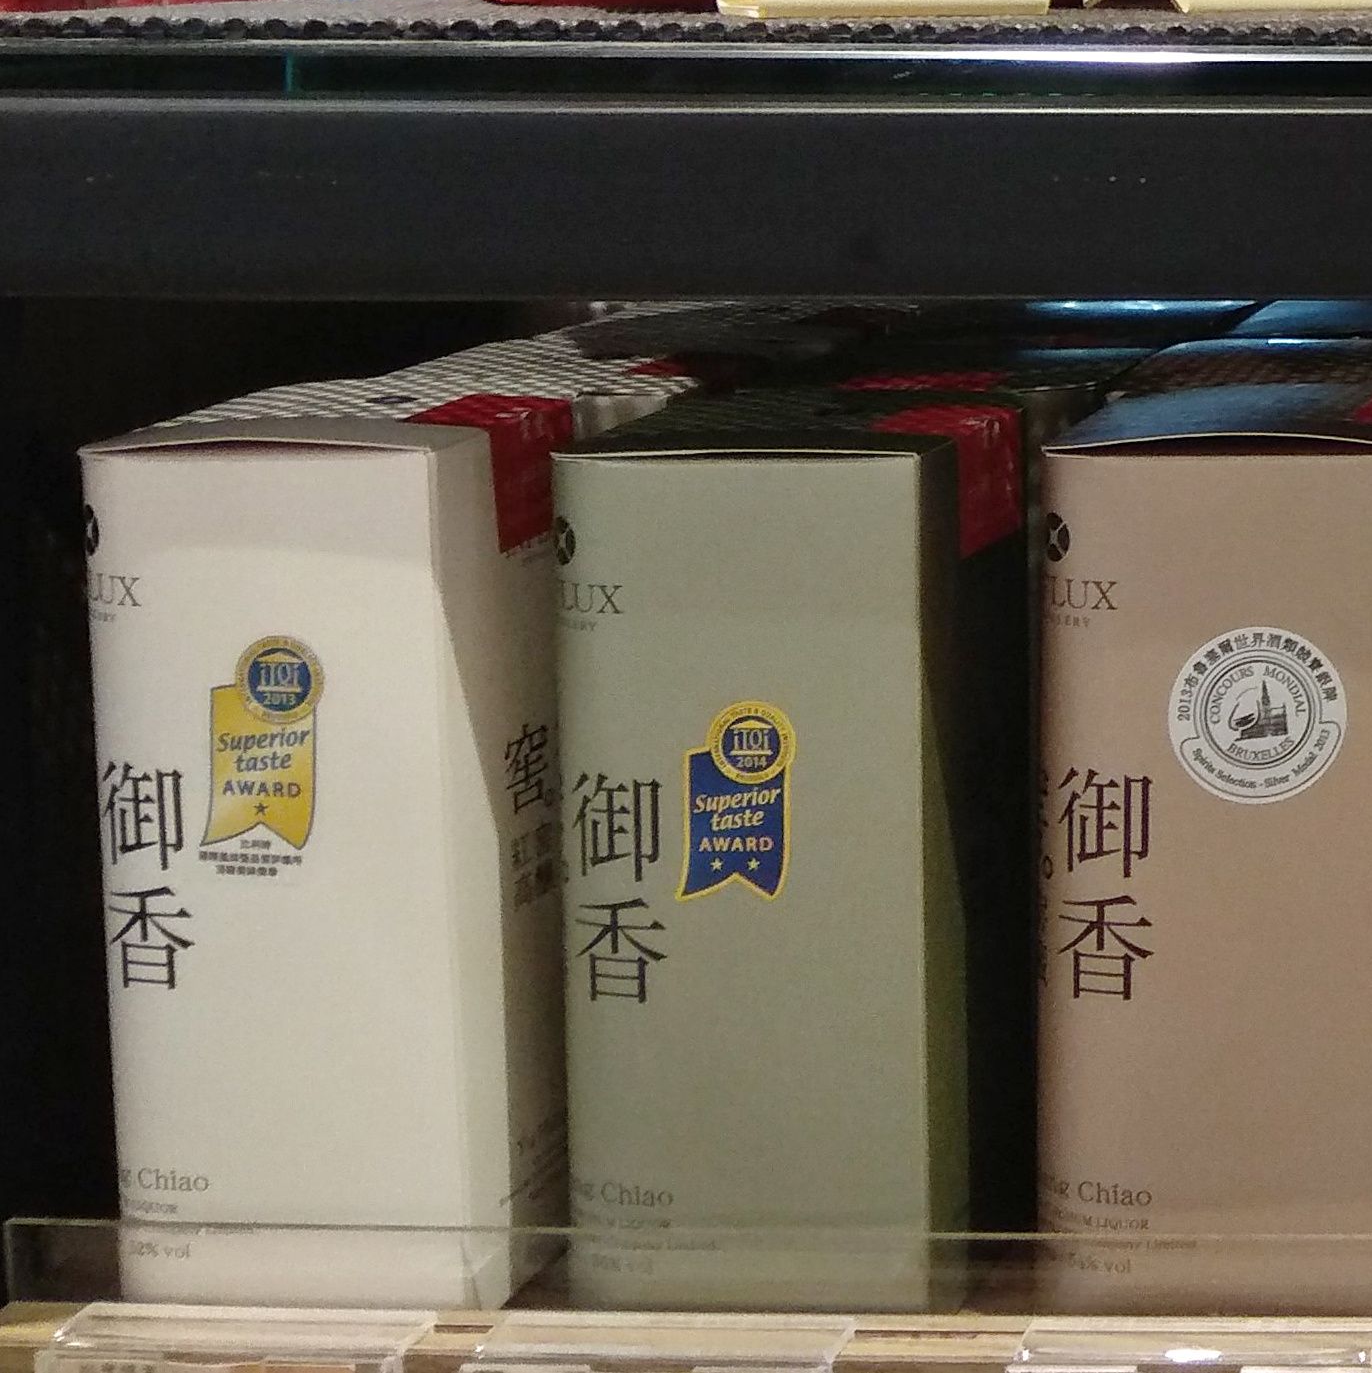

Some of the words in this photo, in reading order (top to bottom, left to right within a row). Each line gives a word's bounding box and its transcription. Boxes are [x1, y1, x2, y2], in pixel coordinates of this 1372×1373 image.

[1209, 665, 1254, 725] CONCOURS
[1263, 665, 1306, 717] MONDIAL
[217, 727, 312, 756] Superior
[1226, 736, 1295, 762] BRUXELLES
[234, 751, 293, 774] taste
[735, 756, 768, 769] 2014
[222, 779, 302, 799] AWARD
[692, 786, 781, 815] Superior
[709, 810, 765, 832] taste
[699, 836, 775, 853] AWARD
[102, 761, 195, 991] 御香
[571, 771, 668, 1006] 御香
[1056, 766, 1155, 1002] 御香
[138, 1166, 211, 1193] Chiao
[600, 1181, 675, 1208] Chiao
[1078, 1180, 1153, 1207] Chiao
